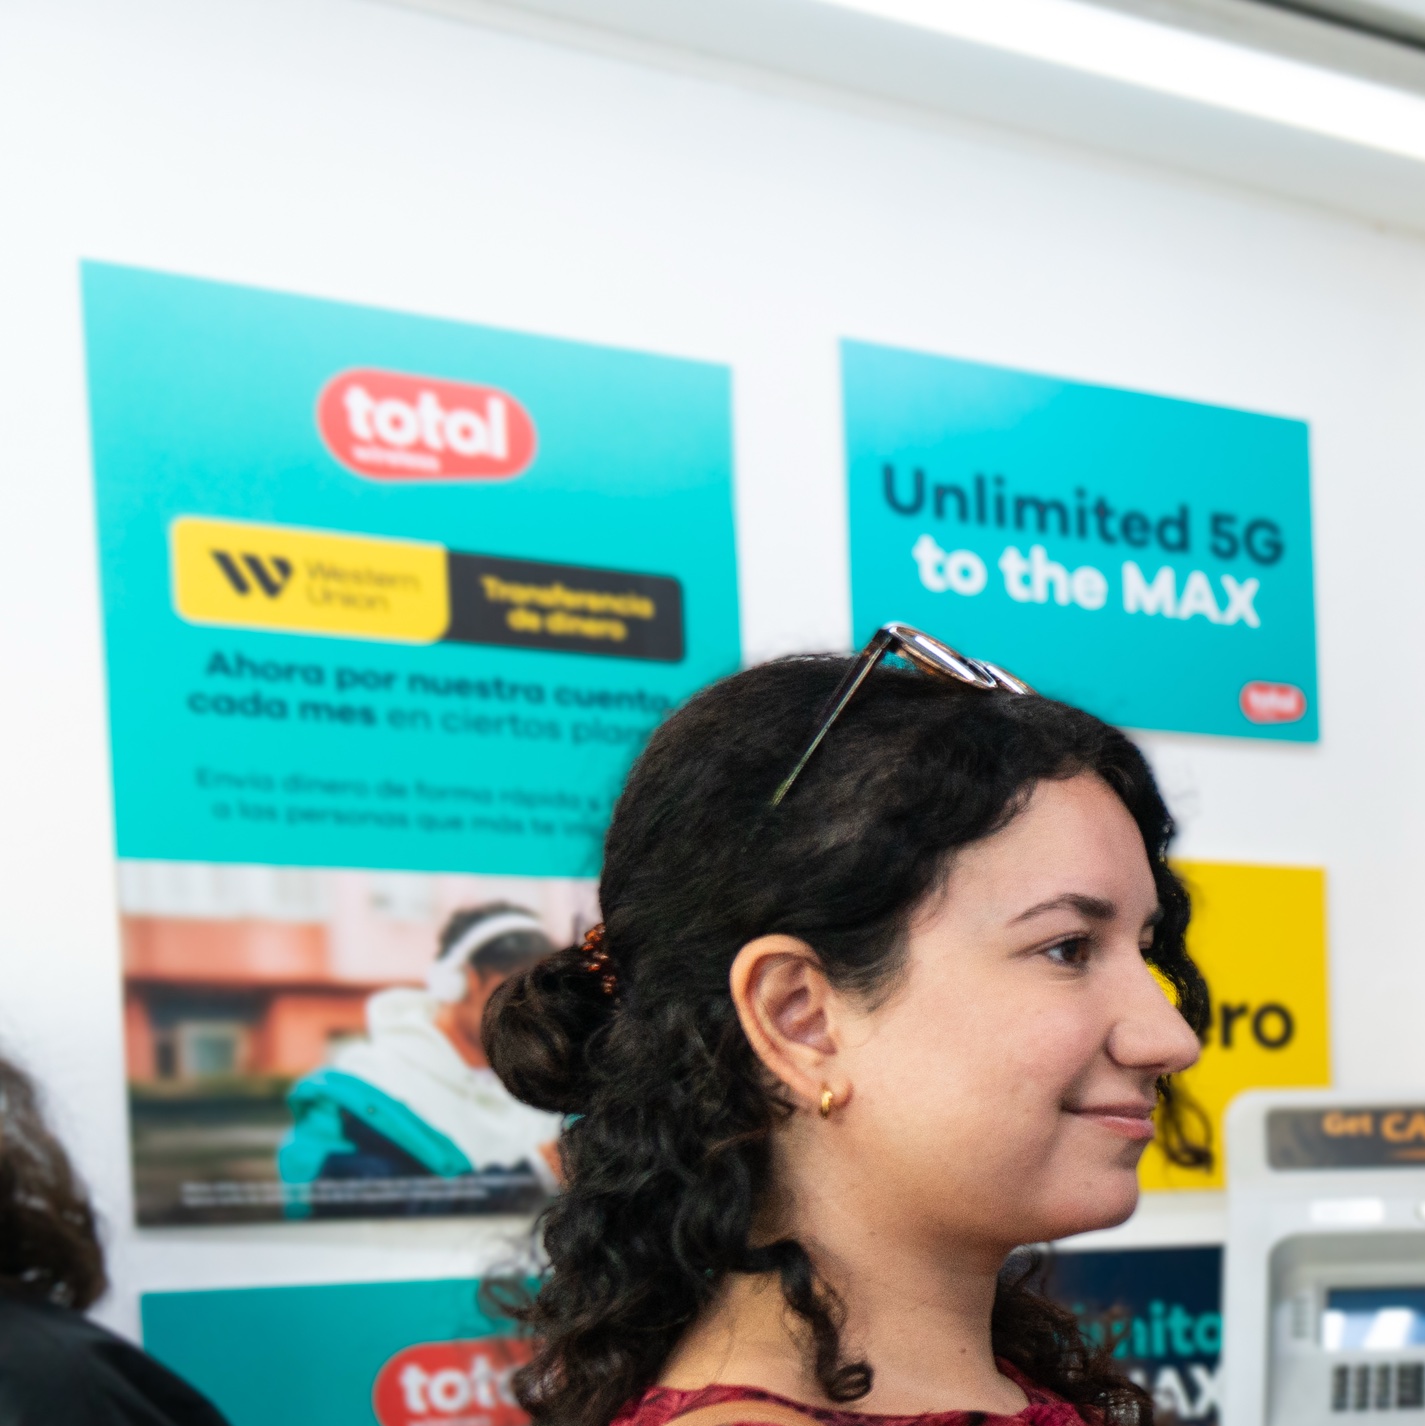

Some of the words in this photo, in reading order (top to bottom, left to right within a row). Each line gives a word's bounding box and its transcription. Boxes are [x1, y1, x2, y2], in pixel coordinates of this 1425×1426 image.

[343, 385, 508, 461] total
[882, 463, 1192, 555] Unlimited
[1208, 511, 1285, 567] 5G
[911, 532, 989, 598] to
[997, 543, 1109, 612] the
[1121, 559, 1261, 630] MAX
[506, 606, 541, 635] de
[545, 610, 628, 643] dinero
[206, 649, 327, 687] Ahora
[335, 664, 397, 693] por
[407, 671, 546, 705] nuestra
[187, 689, 290, 721] cada
[298, 699, 377, 728] mes
[387, 707, 433, 733] en
[440, 706, 561, 743] ciertos
